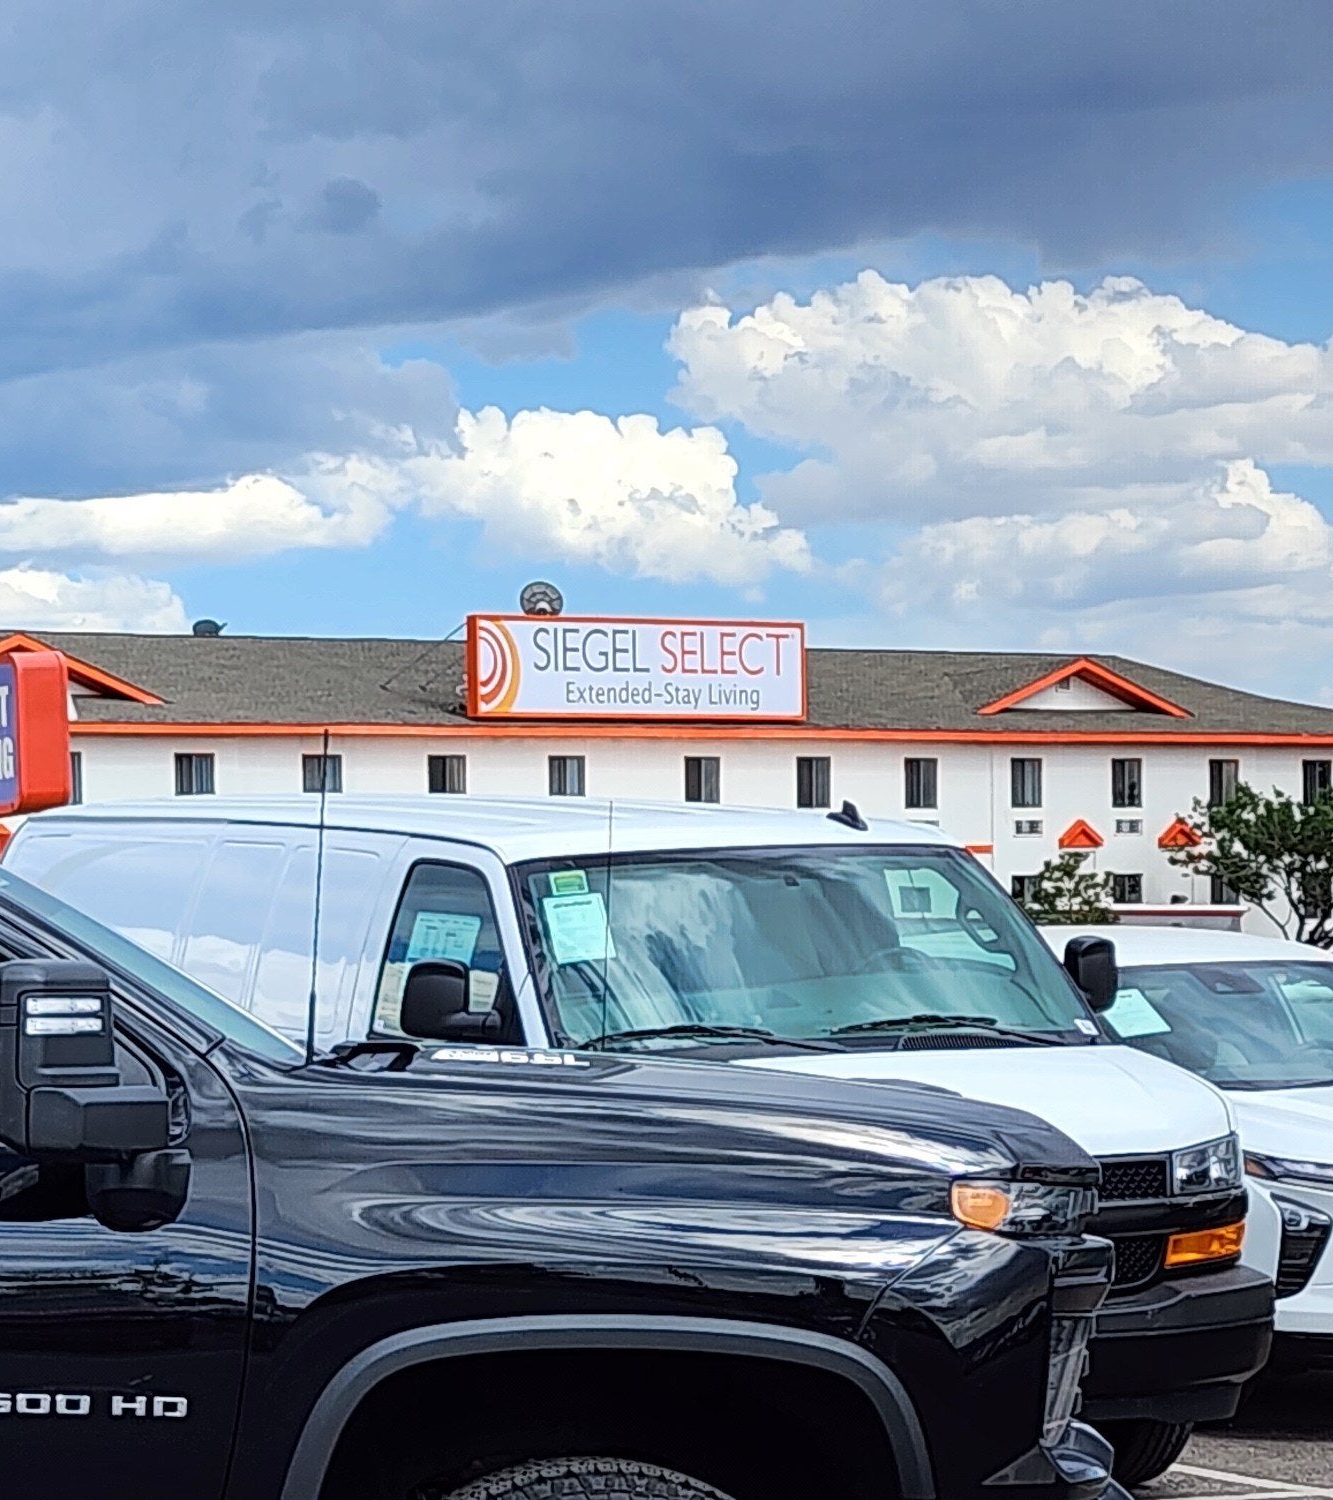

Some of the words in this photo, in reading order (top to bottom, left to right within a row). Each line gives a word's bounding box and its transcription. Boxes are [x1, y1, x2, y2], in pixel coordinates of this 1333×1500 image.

[532, 627, 651, 673] SIEGEL
[660, 630, 791, 676] SELECT
[566, 681, 702, 710] Extended-Stay
[708, 683, 760, 711] Living
[111, 1396, 188, 1417] HD
